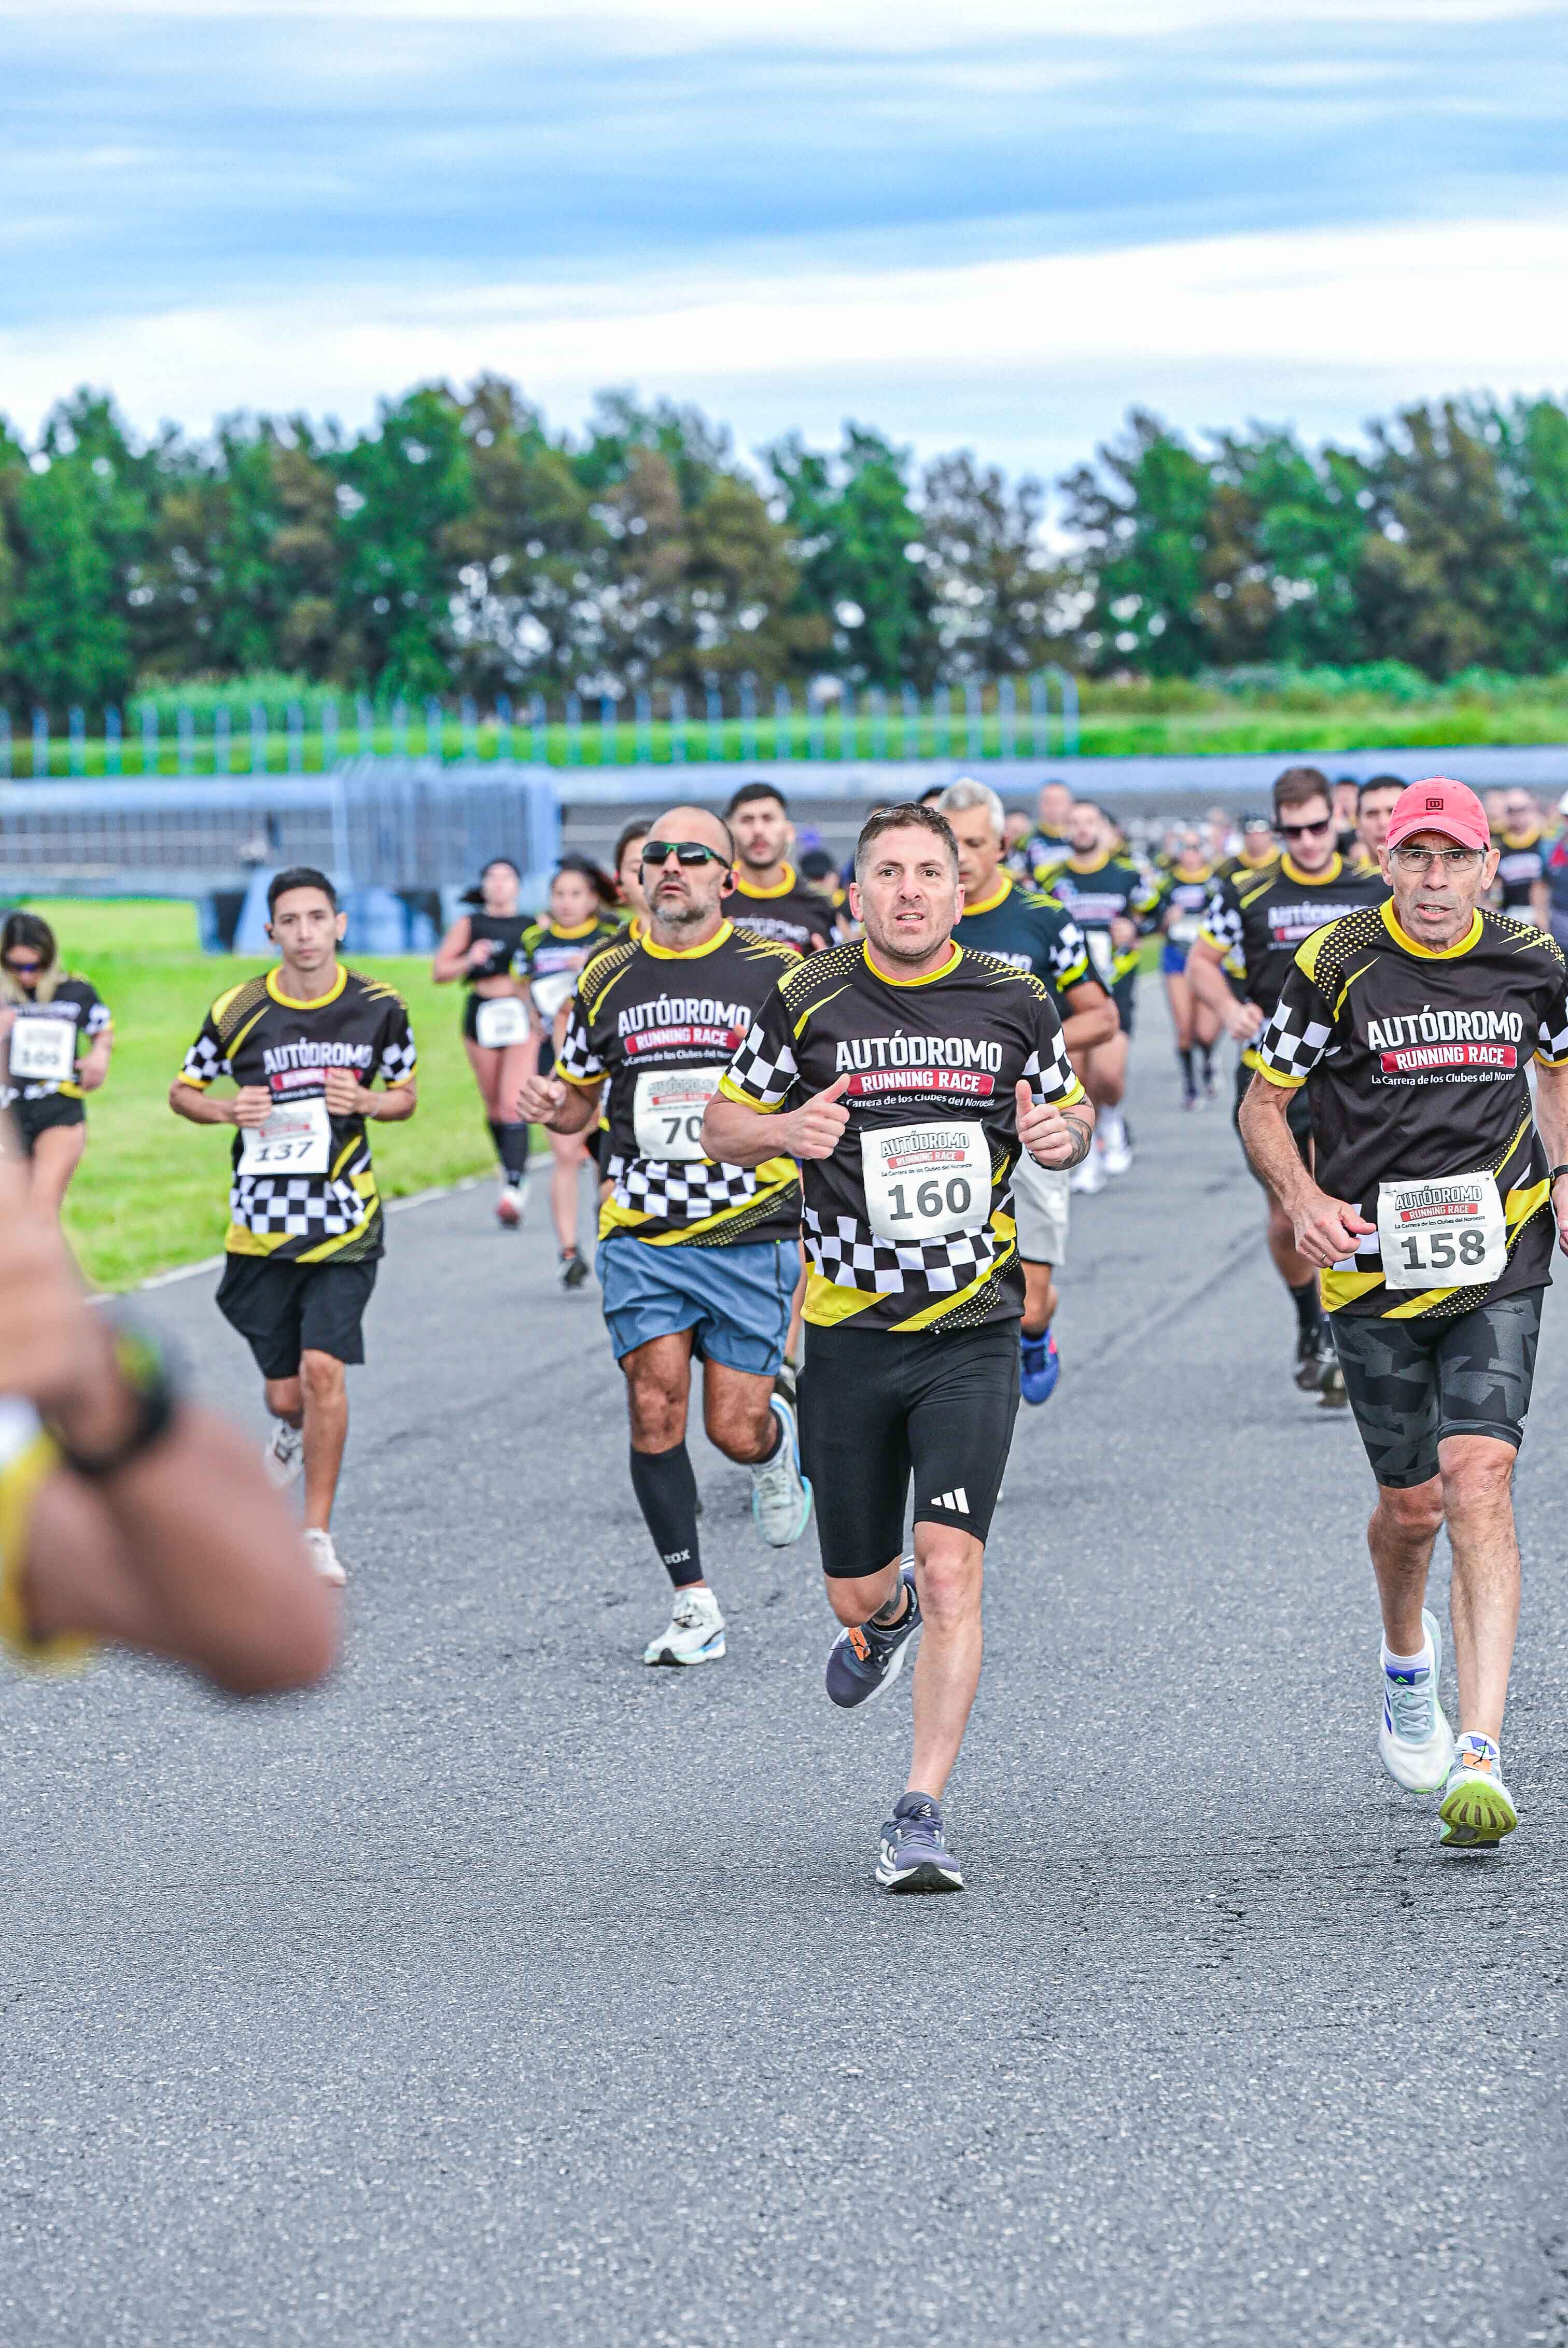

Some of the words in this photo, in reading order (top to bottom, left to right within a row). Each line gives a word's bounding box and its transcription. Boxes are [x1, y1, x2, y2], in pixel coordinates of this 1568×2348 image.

[618, 993, 752, 1037] AUTÓDROMO
[1367, 1004, 1523, 1051] AUTÓDROMO
[635, 1029, 691, 1051] RUNNING
[693, 1028, 729, 1046] RACE
[835, 1029, 1003, 1073] AUTÓDROMO
[263, 1037, 373, 1074] AUTÓDROMO
[1395, 1046, 1464, 1070] RUNNING
[1468, 1046, 1505, 1065] RACE
[860, 1071, 933, 1093] RUNNING
[938, 1072, 981, 1093] RACE
[1371, 1075, 1381, 1084] La
[1382, 1076, 1415, 1085] Carrera
[1418, 1075, 1428, 1084] de
[1431, 1074, 1444, 1083] los
[1446, 1073, 1477, 1082] Clubes
[1479, 1072, 1493, 1082] del
[884, 1096, 897, 1106] de
[899, 1094, 912, 1103] los
[915, 1094, 946, 1102] Clubes
[948, 1094, 964, 1106] del
[662, 1116, 703, 1144] 70
[255, 1141, 315, 1162] 137
[881, 1131, 970, 1158] AUTÓDROMO
[935, 1152, 956, 1161] RACE
[888, 1178, 971, 1220] 160
[1395, 1185, 1482, 1210] AUTÓDROMO
[1409, 1206, 1446, 1220] RUNNING
[1448, 1205, 1469, 1214] RACE
[1401, 1229, 1485, 1269] 158
